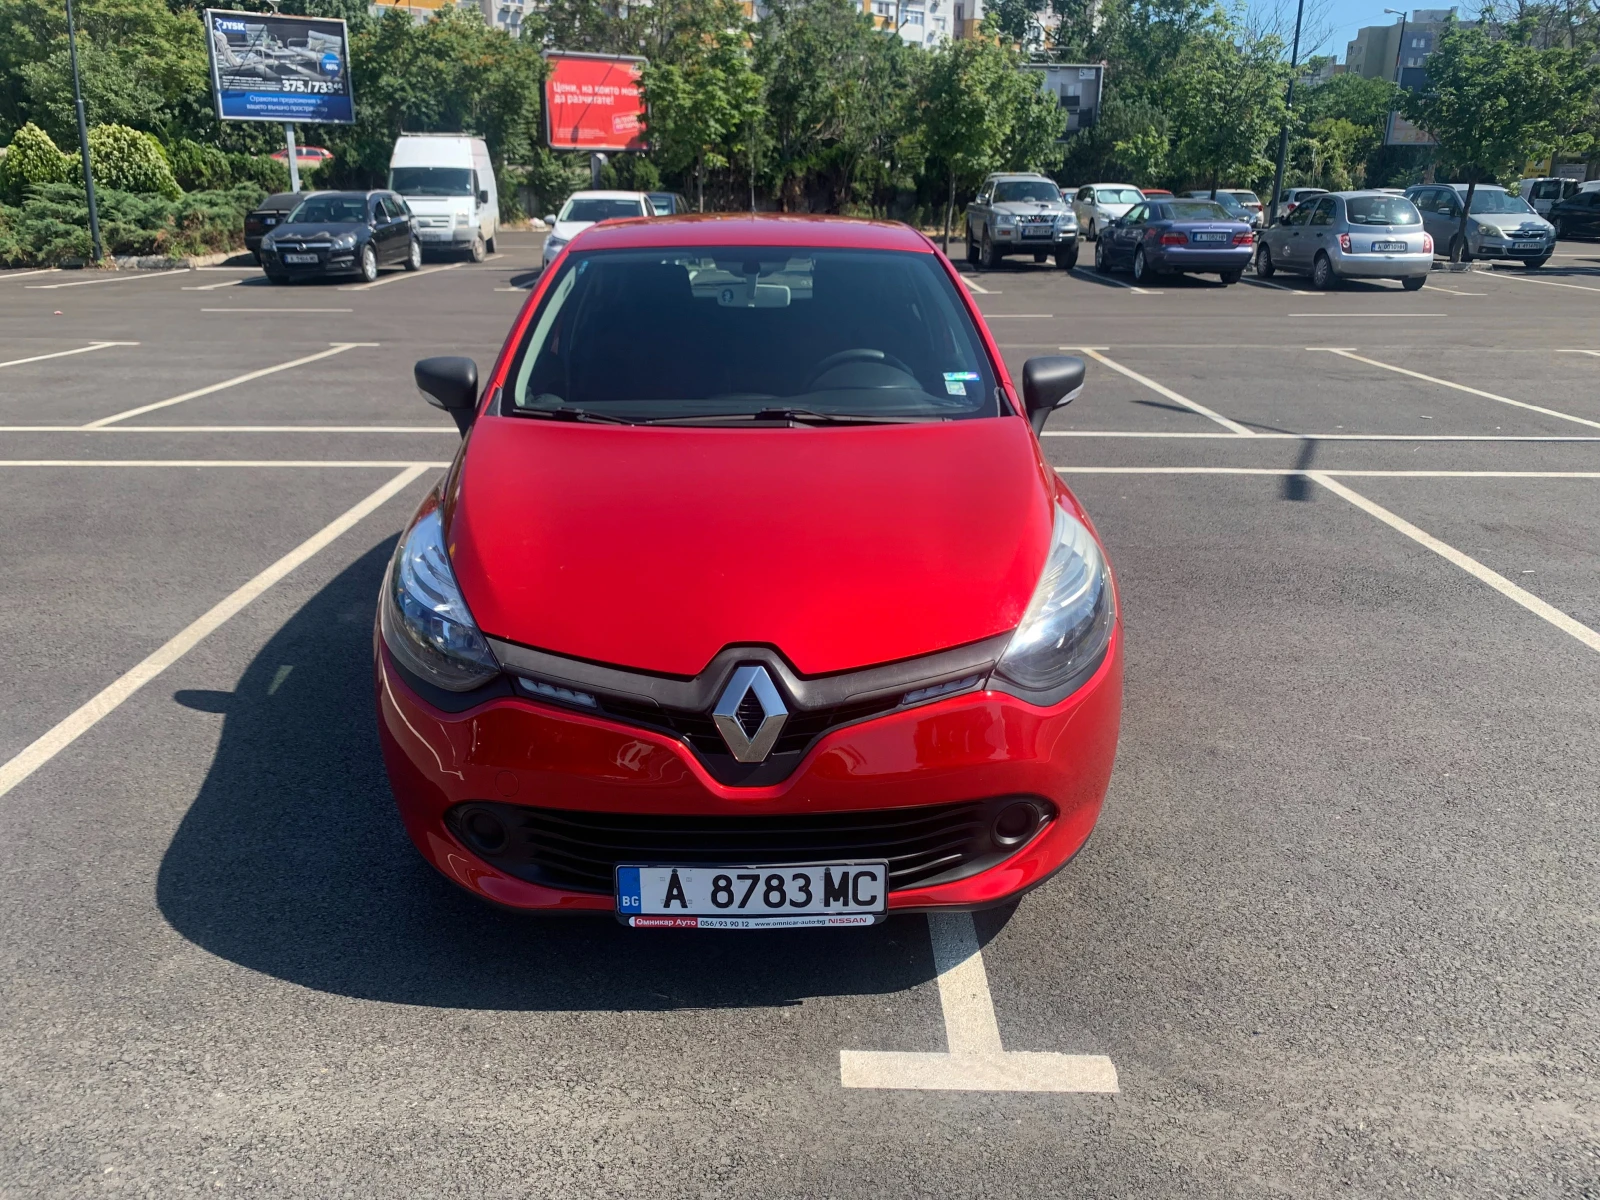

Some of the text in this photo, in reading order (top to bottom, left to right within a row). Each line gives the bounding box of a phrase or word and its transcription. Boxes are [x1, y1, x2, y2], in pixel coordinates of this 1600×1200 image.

[222, 21, 245, 30] JYSK
[553, 82, 579, 94] Цени,
[581, 85, 593, 94] на
[554, 94, 614, 105] да разчитате!
[663, 871, 877, 908] A 8783 MC
[622, 895, 639, 906] BG
[636, 918, 674, 926] Омникар
[675, 918, 697, 927] Ауто
[754, 918, 826, 927] www.omnicar-auto.bg
